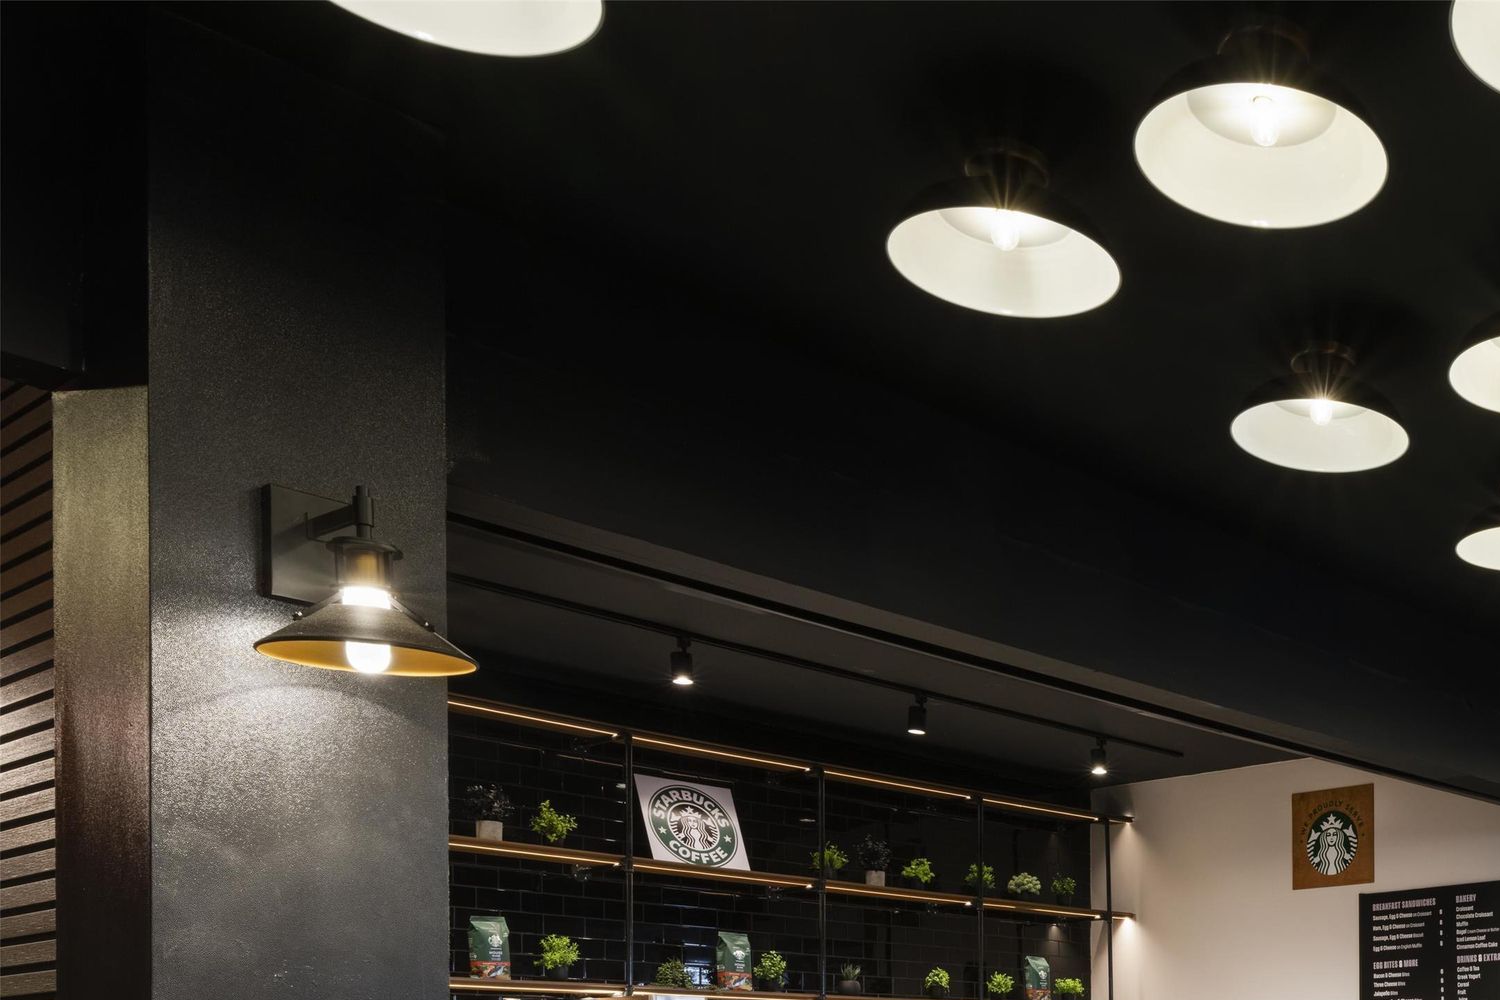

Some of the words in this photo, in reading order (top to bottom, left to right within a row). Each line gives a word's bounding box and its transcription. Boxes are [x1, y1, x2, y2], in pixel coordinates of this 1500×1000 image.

[653, 789, 730, 828] STARBUCKS
[1308, 800, 1344, 820] PROUDLY
[669, 840, 728, 865] COFFEE
[1372, 901, 1401, 912] BREAKFAST
[1401, 898, 1436, 909] SANDWICHES
[1455, 894, 1476, 903] BAKERY
[1384, 961, 1398, 969] BITES
[1399, 960, 1403, 968] &
[1404, 959, 1418, 967] MORE
[1457, 954, 1477, 963] DRINKS
[1478, 954, 1482, 962] &
